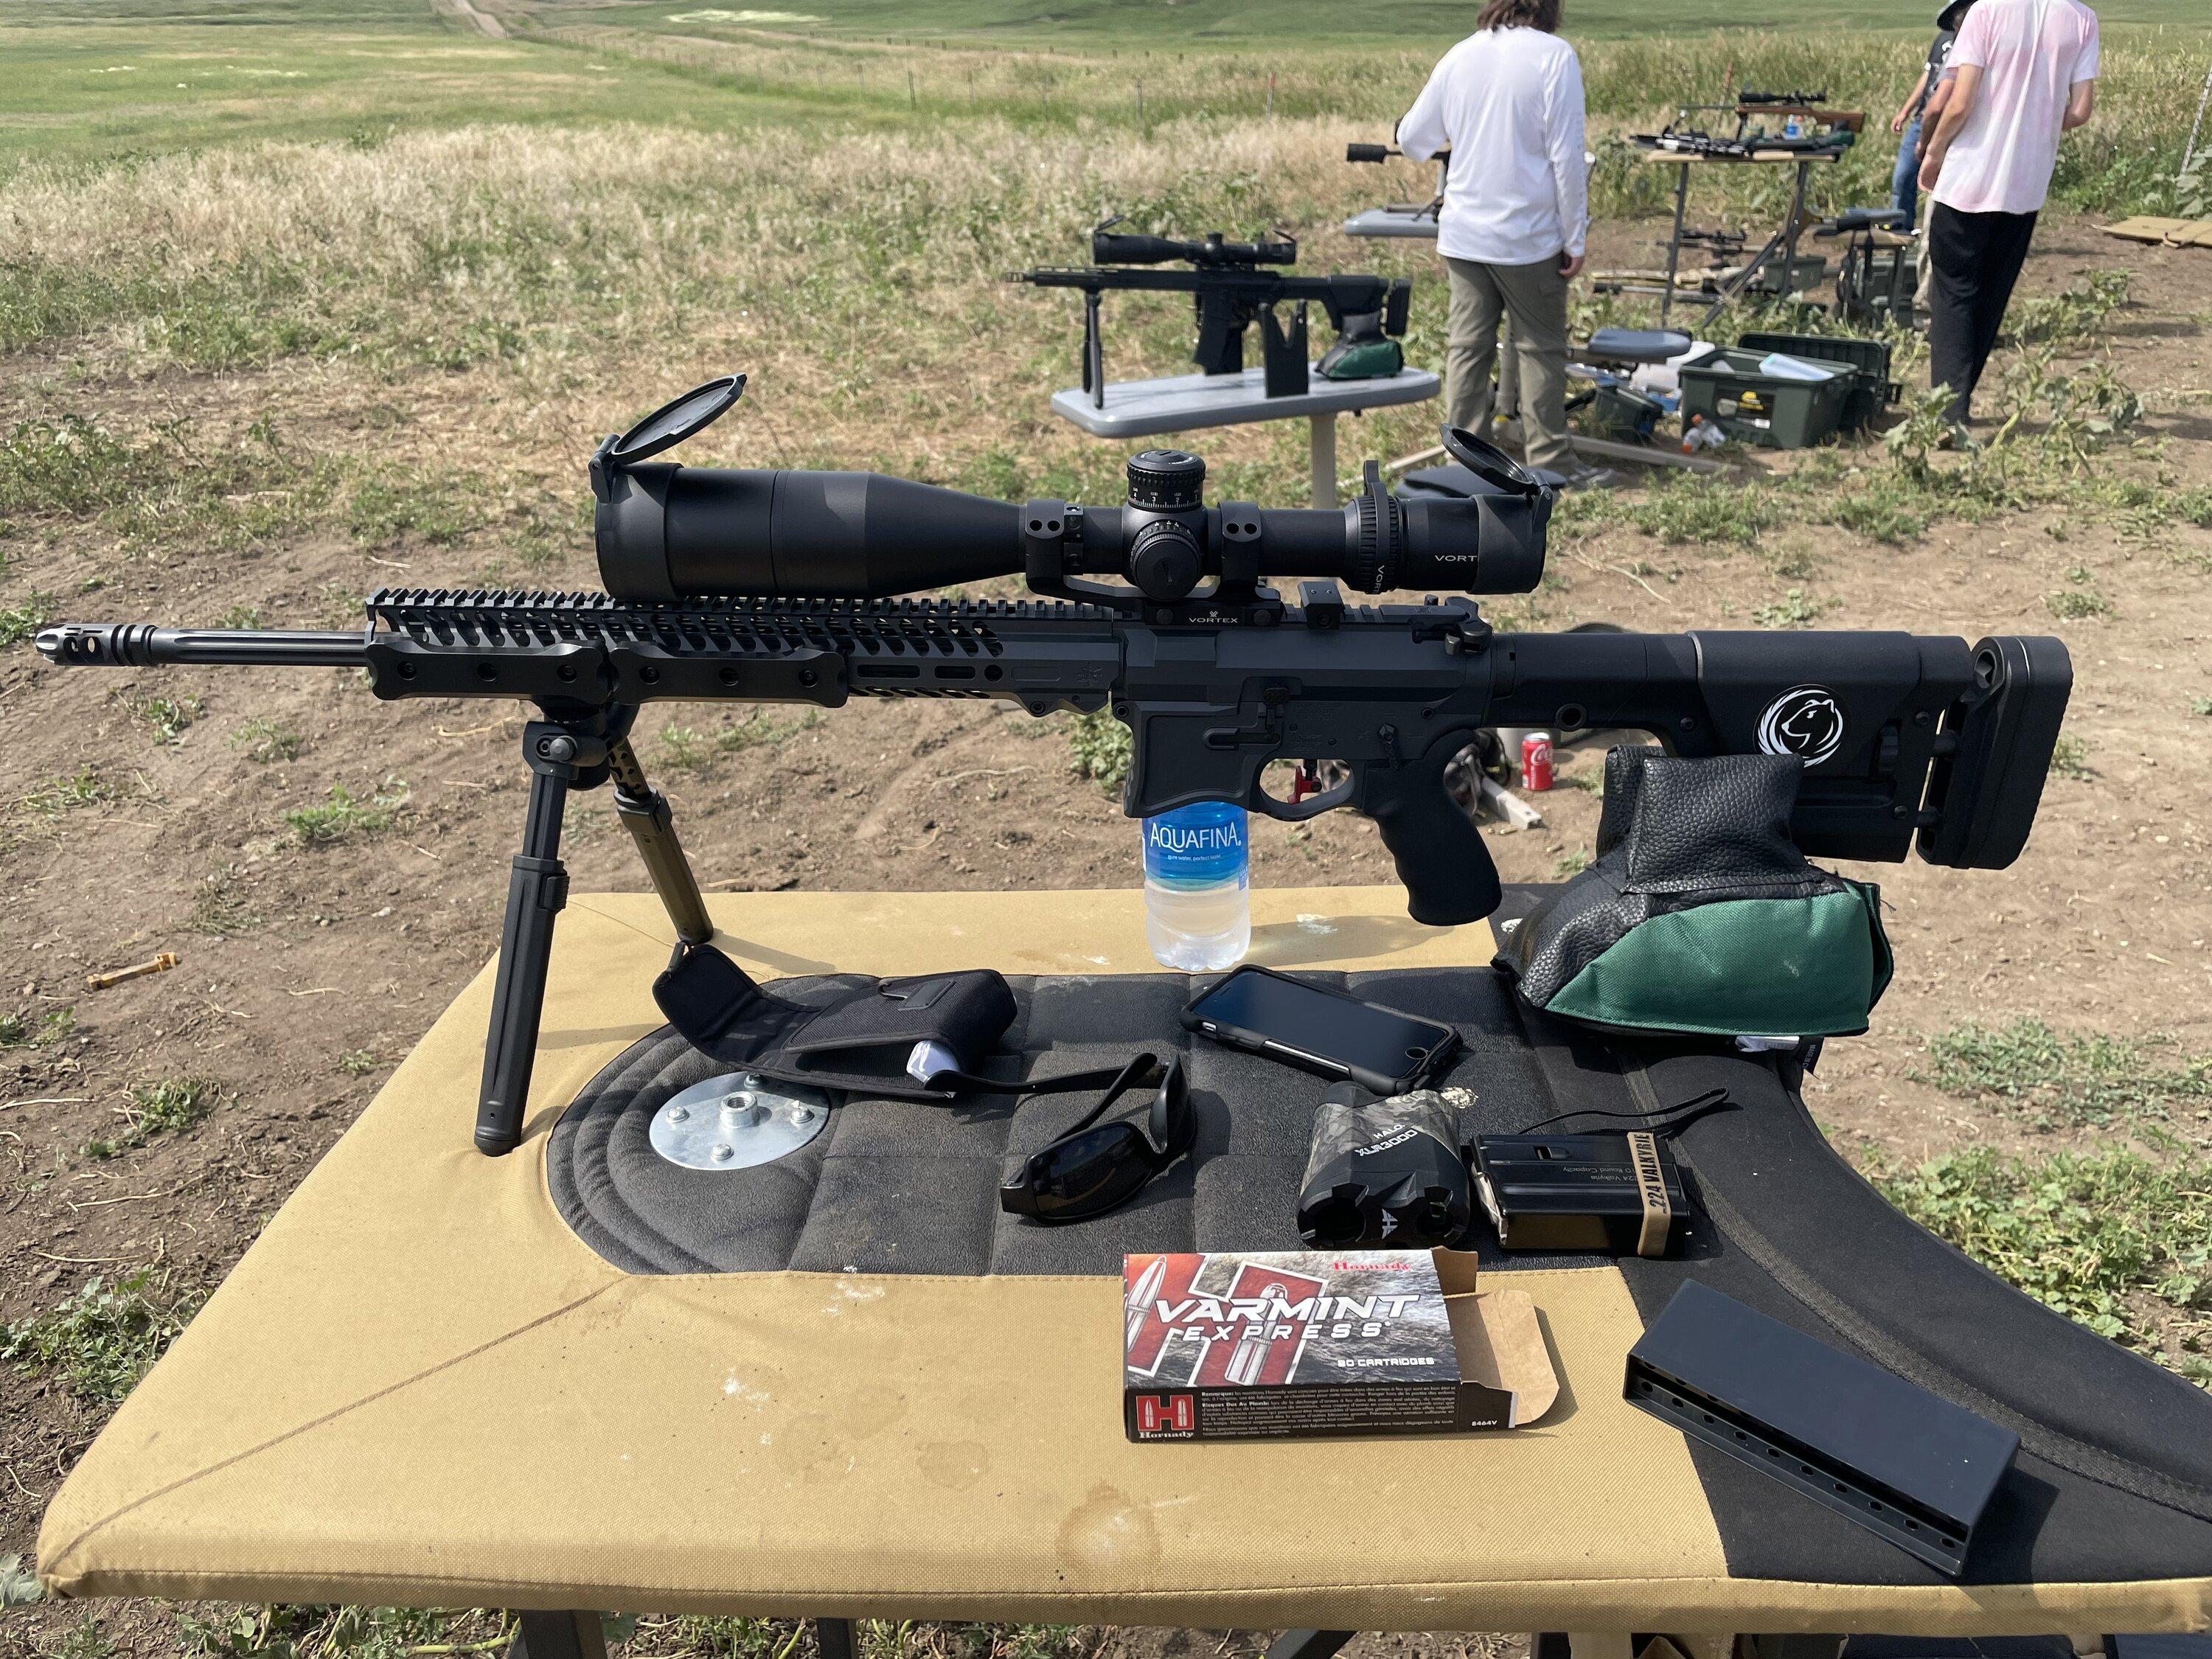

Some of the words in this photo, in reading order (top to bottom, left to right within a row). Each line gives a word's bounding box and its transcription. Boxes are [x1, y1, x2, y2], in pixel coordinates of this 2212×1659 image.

[1150, 821, 1239, 853] AQUAFINA
[1354, 1129, 1418, 1156] XLR3000
[1633, 1134, 1660, 1182] VALKYRIE
[1332, 1262, 1411, 1271] Hornady
[1155, 1294, 1420, 1323] VARMINT
[1182, 1322, 1382, 1341] EXPRESS
[1357, 1357, 1435, 1367] CARTRIDGES
